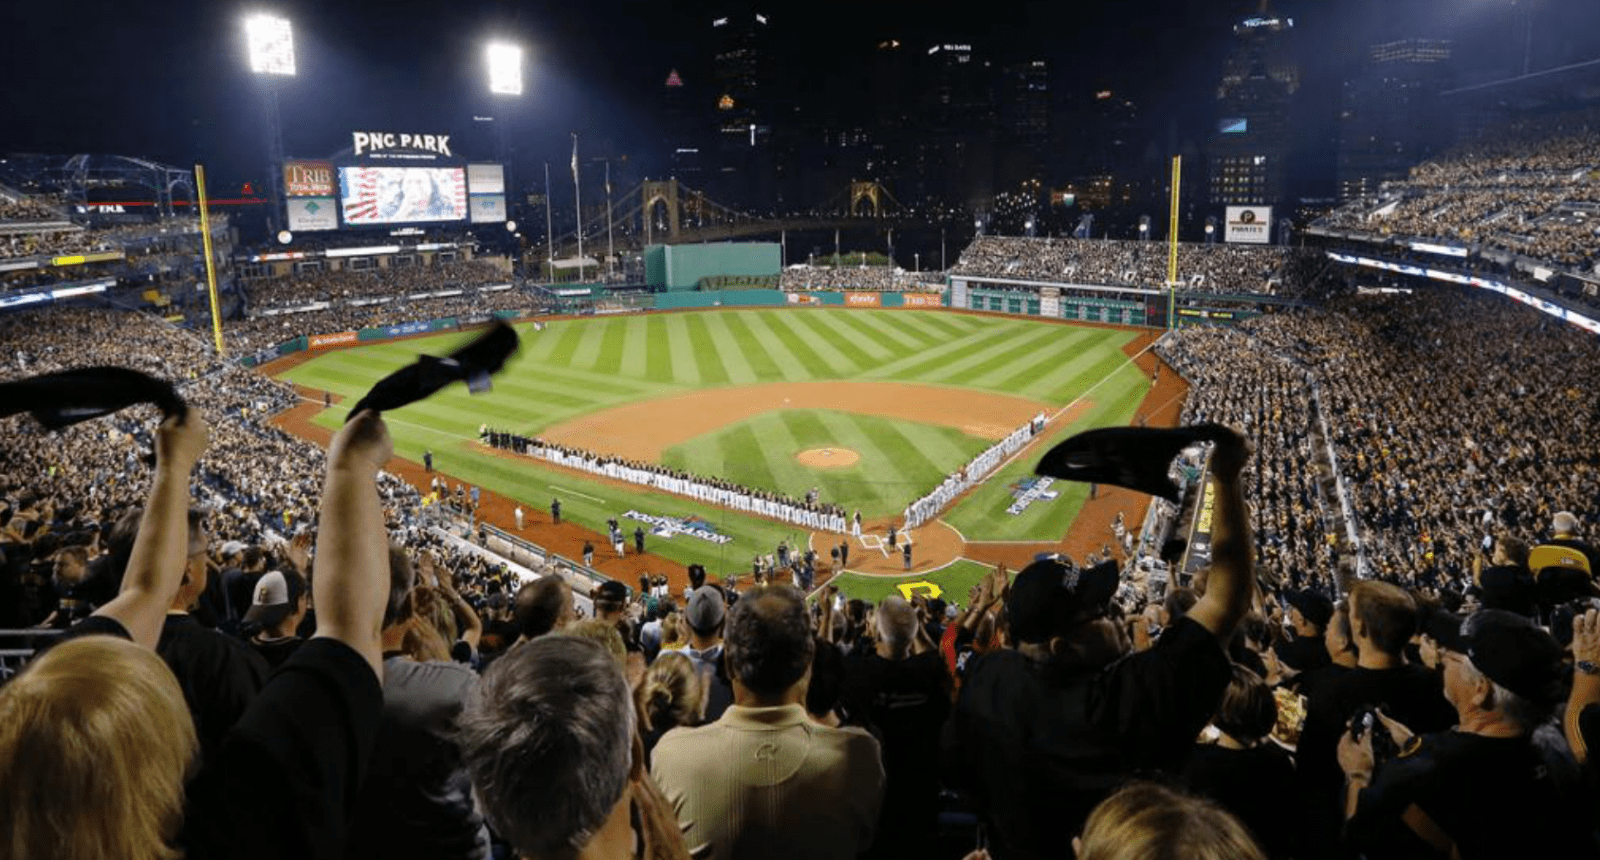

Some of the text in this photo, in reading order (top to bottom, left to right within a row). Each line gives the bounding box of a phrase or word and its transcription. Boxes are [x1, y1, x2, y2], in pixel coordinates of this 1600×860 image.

[353, 131, 452, 157] PNC PARK
[286, 165, 331, 183] TRIB
